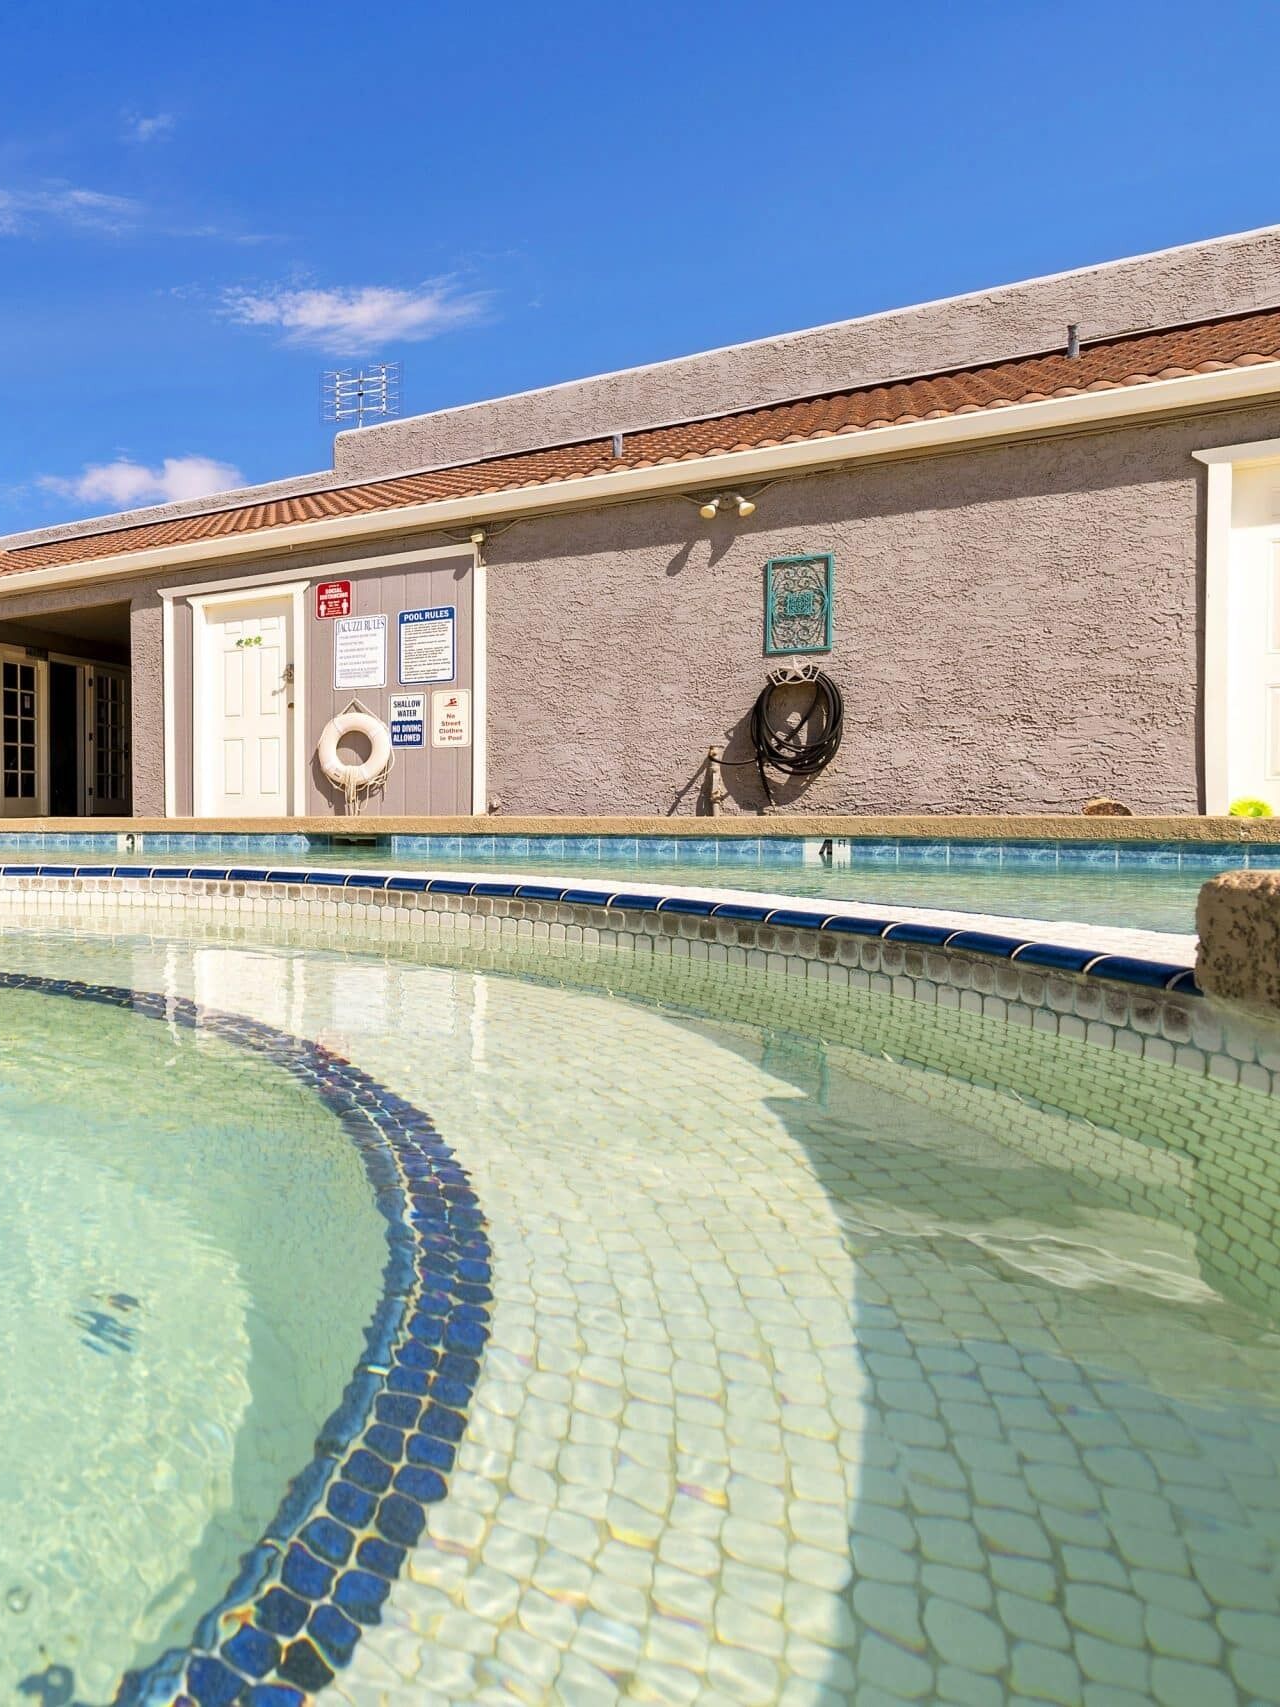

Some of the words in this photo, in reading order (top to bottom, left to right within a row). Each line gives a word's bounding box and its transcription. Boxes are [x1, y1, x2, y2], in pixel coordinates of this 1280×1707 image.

[404, 612, 424, 622] POOL
[425, 609, 449, 620] RULES
[337, 620, 363, 633] JACUZZI
[364, 618, 385, 631] RULES
[393, 699, 421, 709] SHALLOW
[397, 709, 417, 718] WATER
[392, 725, 401, 733] NO
[401, 724, 422, 733] DIVING
[439, 727, 463, 735] Clothes
[393, 733, 421, 743] ALLOWED
[818, 838, 832, 855] 4
